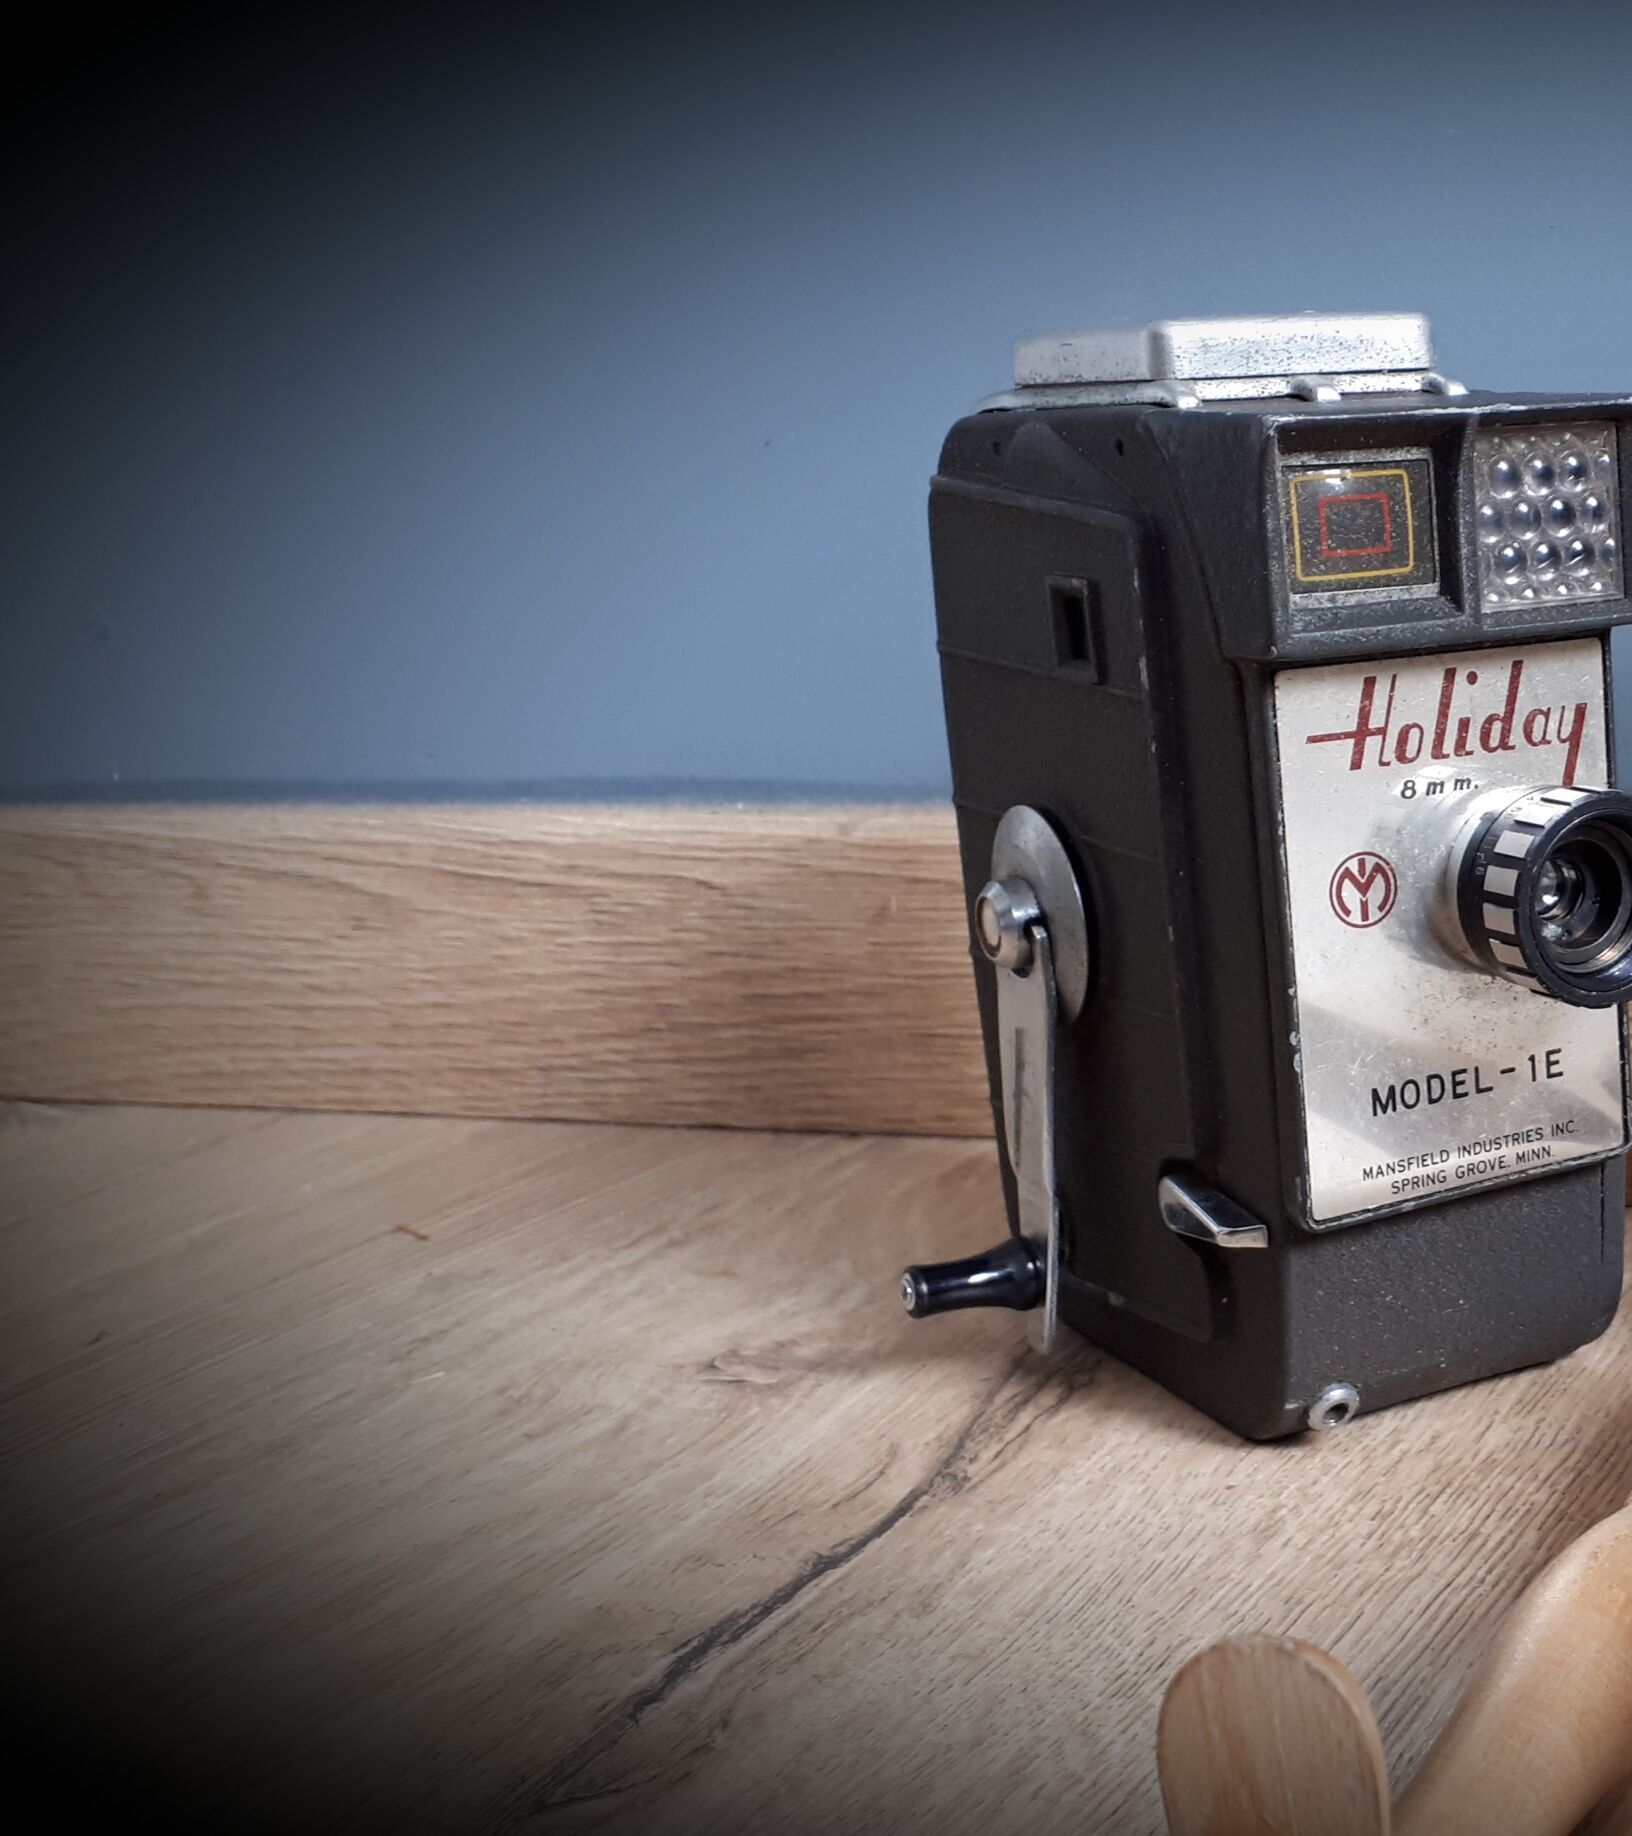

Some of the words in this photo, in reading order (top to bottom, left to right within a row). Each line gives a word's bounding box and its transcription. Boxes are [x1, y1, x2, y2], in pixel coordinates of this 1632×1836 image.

[1305, 659, 1589, 788] Holiday
[1361, 1148, 1451, 1182] MANSFIELD
[1456, 1126, 1545, 1160] INDUSTRIES
[1390, 1169, 1448, 1195] SPRING
[1515, 1144, 1556, 1166] MINN.
